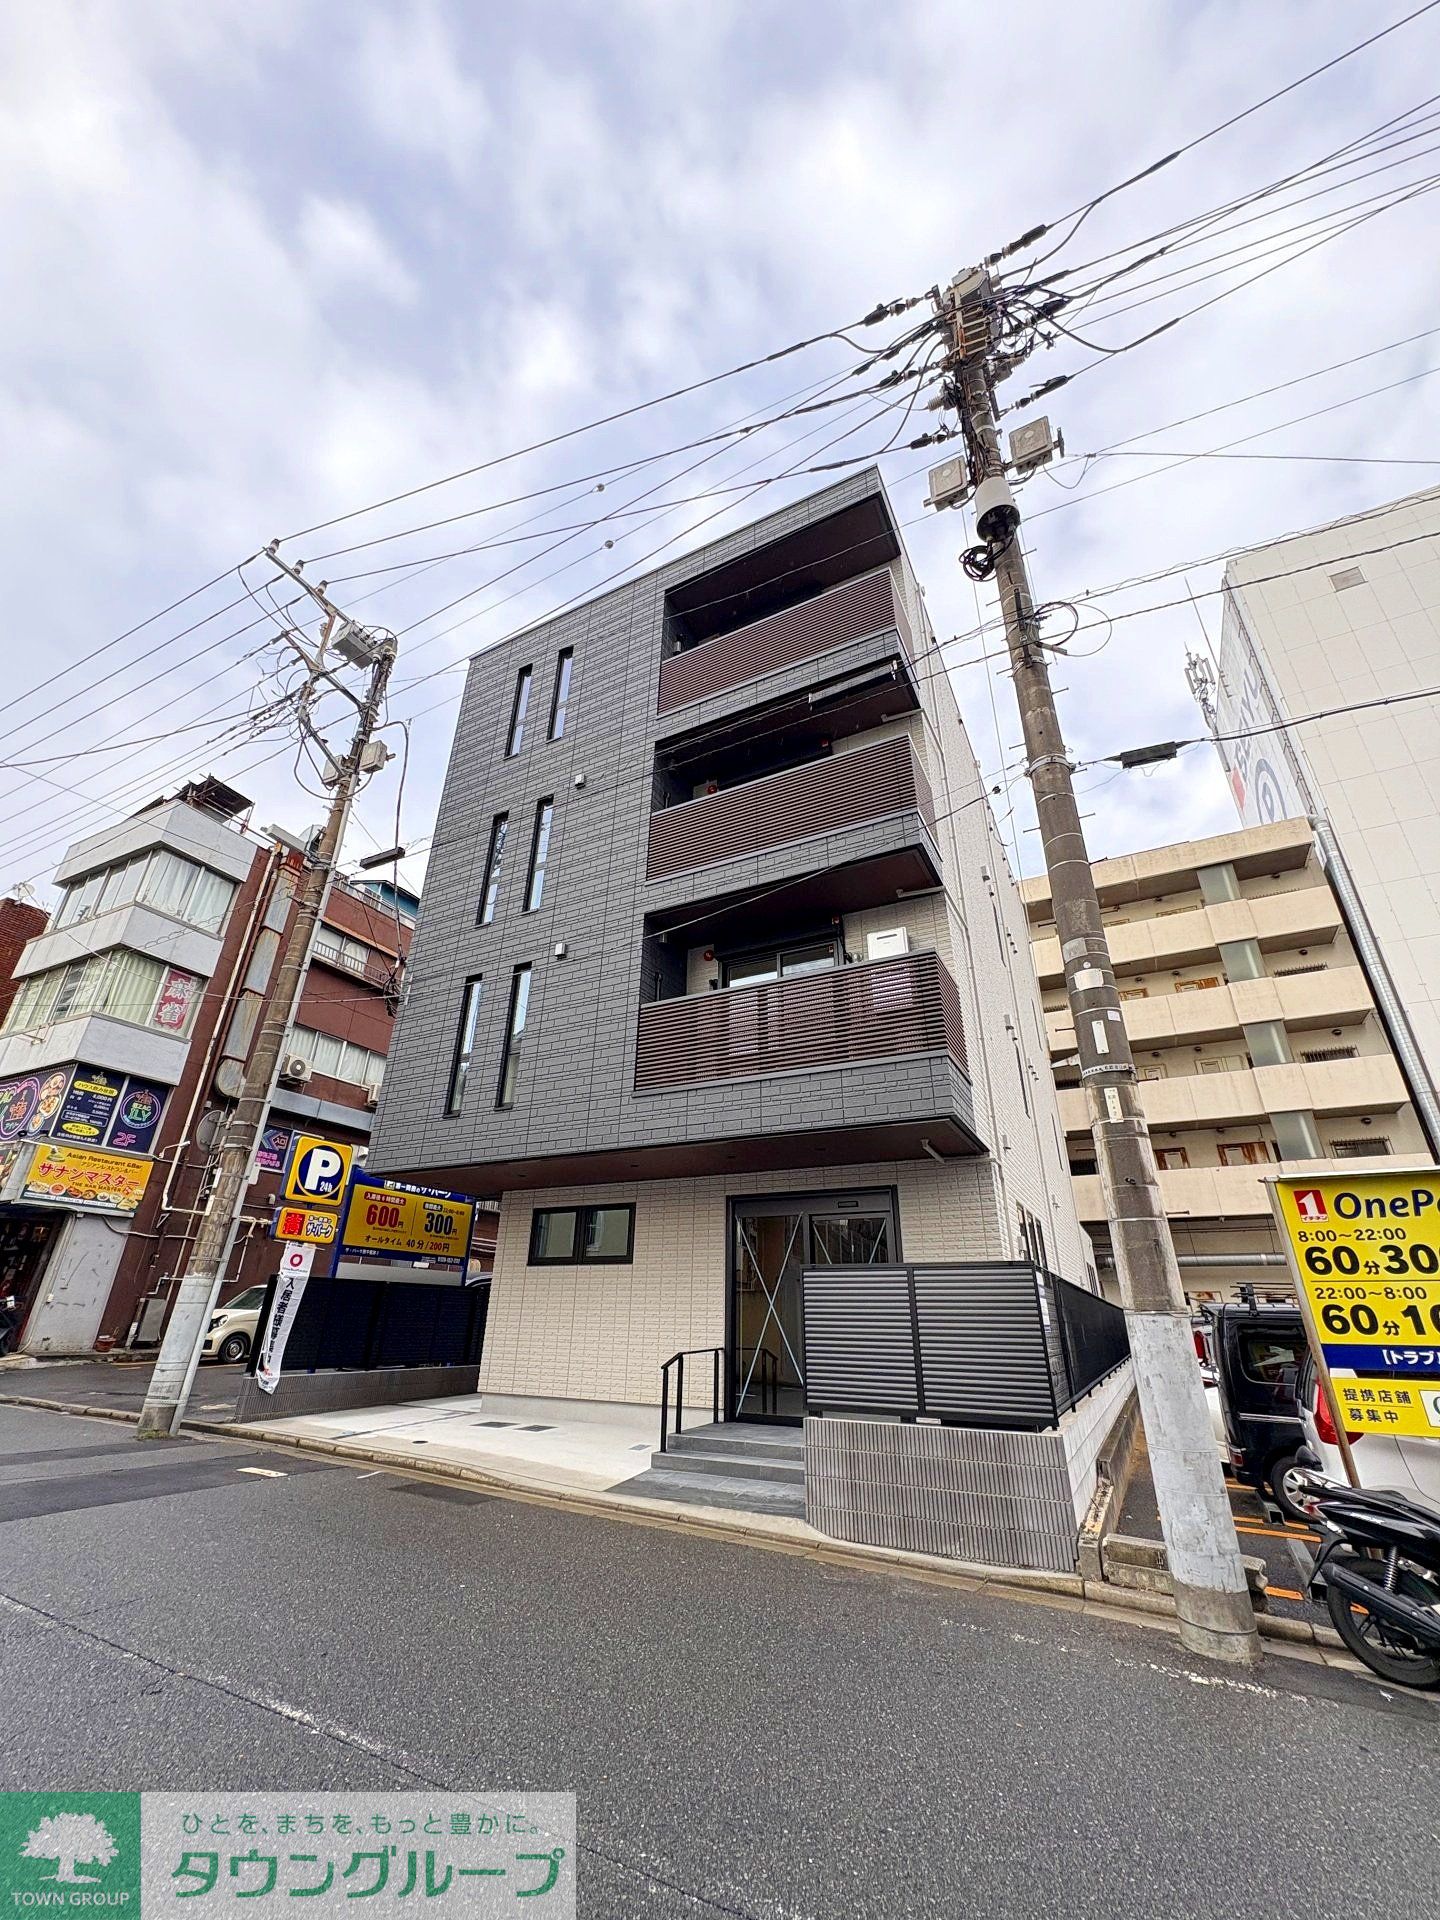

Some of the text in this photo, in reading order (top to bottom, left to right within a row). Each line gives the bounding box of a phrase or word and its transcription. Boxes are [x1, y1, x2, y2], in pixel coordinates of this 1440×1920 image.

[158, 978, 192, 1022] 麻雀
[112, 1131, 137, 1147] 2F
[66, 1152, 87, 1161] Asian
[88, 1155, 126, 1166] Restaurant
[38, 1162, 141, 1188] サナンマスター
[304, 1148, 341, 1191] P
[319, 1180, 334, 1193] 24h
[1333, 1188, 1440, 1220] OneP
[366, 1204, 404, 1228] 600円
[424, 1212, 458, 1236] 300円
[364, 1235, 402, 1247] オールタイム
[1297, 1227, 1407, 1243] 8:00~22:00
[1305, 1243, 1440, 1276] 60分30
[1314, 1286, 1428, 1300] 22:00~8:00
[1382, 1349, 1440, 1365] 【トラブ
[1342, 1387, 1412, 1405] 提携店舗
[1348, 1407, 1399, 1424] 募集中
